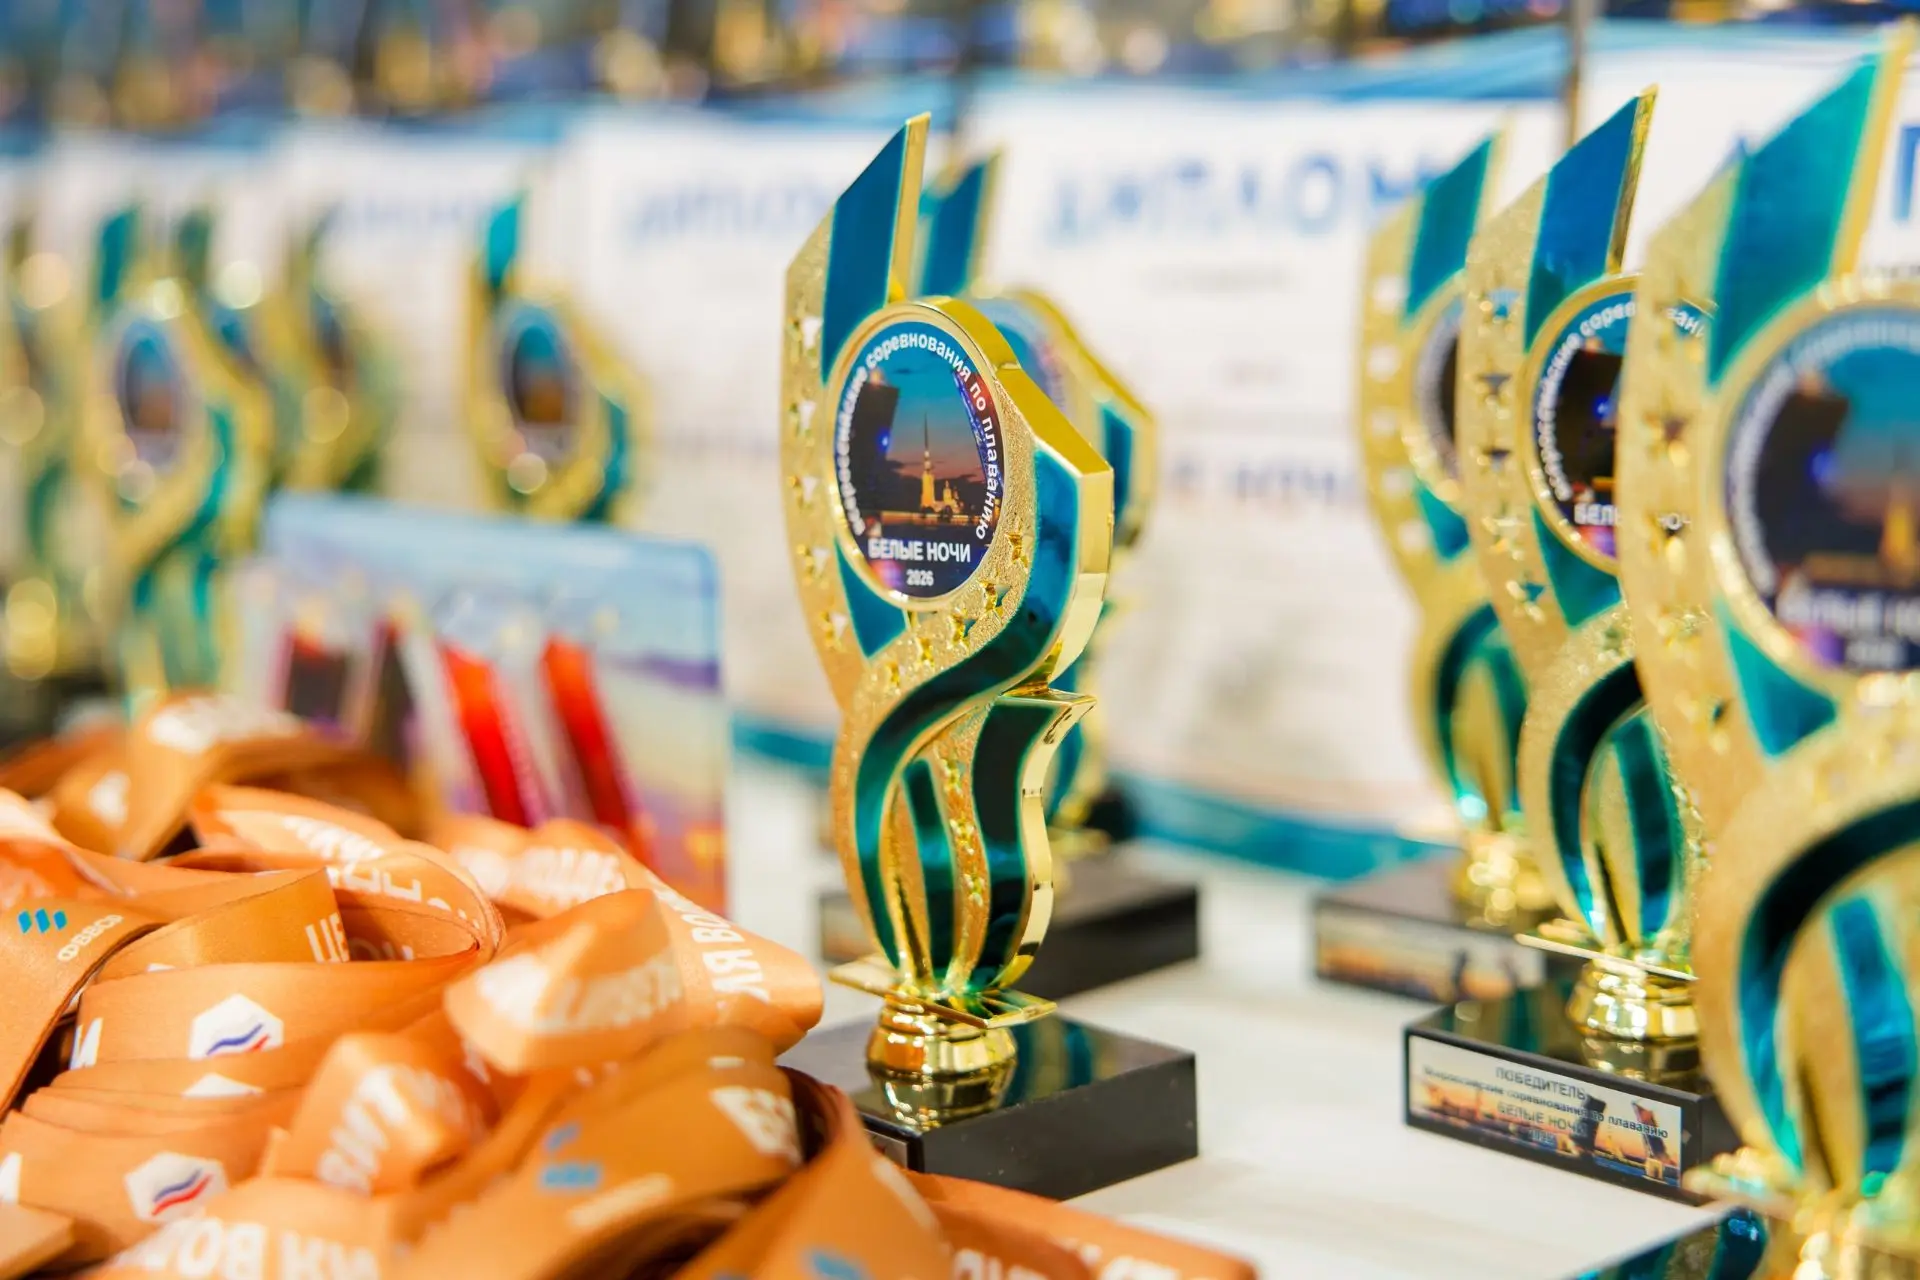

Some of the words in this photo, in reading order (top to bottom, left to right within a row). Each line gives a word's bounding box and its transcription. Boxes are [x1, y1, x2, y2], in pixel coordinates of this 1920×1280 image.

[866, 332, 971, 382] соревнования
[969, 382, 987, 412] по
[976, 417, 998, 540] плаванию
[868, 537, 924, 561] БЕЛЫЕ
[926, 541, 971, 563] НОЧИ
[1495, 1067, 1586, 1101] ПОБЕДИТЕЛЬ
[1608, 1115, 1668, 1139] плаванию
